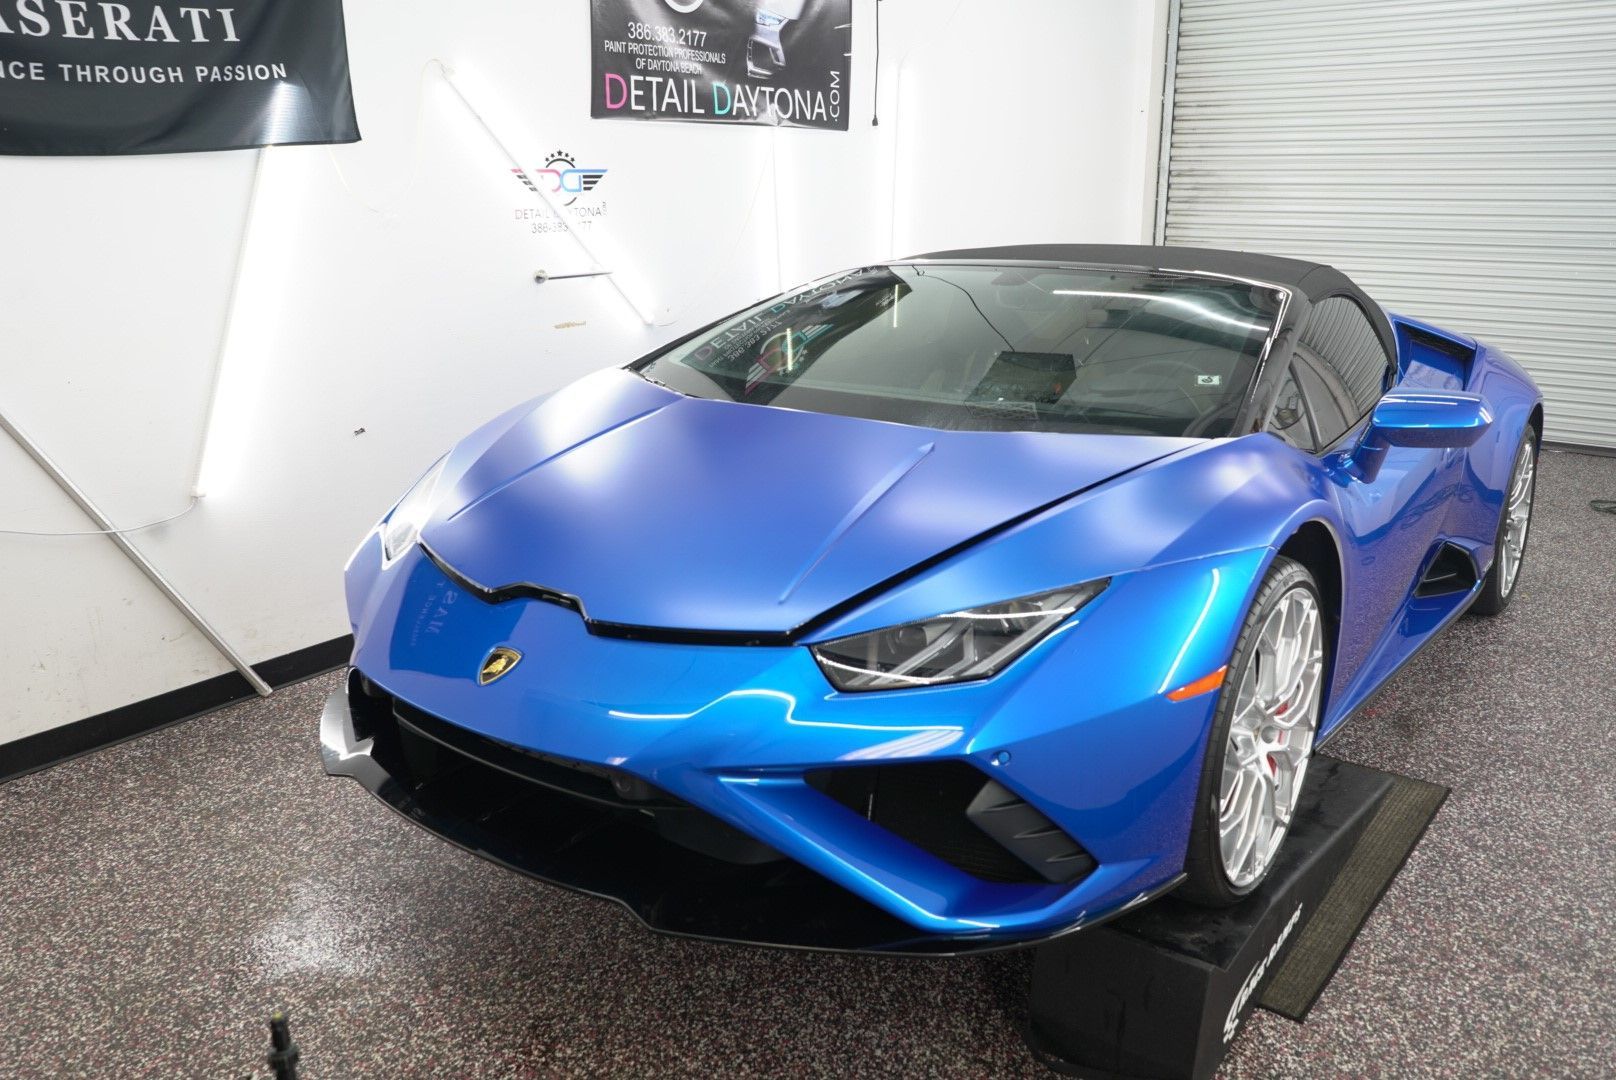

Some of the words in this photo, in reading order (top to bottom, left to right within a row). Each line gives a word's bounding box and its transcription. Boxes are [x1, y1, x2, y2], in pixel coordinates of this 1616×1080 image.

[627, 21, 707, 48] 386.383.2177
[604, 39, 627, 54] PAINT
[628, 42, 674, 59] PROTECTION
[674, 46, 726, 64] PROFESSIONALS
[58, 63, 184, 83] THROUGH
[196, 63, 287, 82] PASSION
[635, 57, 647, 70] OF
[647, 59, 680, 73] DAYTONA
[681, 61, 703, 75] BEACH
[604, 73, 705, 114] DETAIL
[712, 81, 827, 121] DAYTONA
[829, 70, 840, 122] .COM
